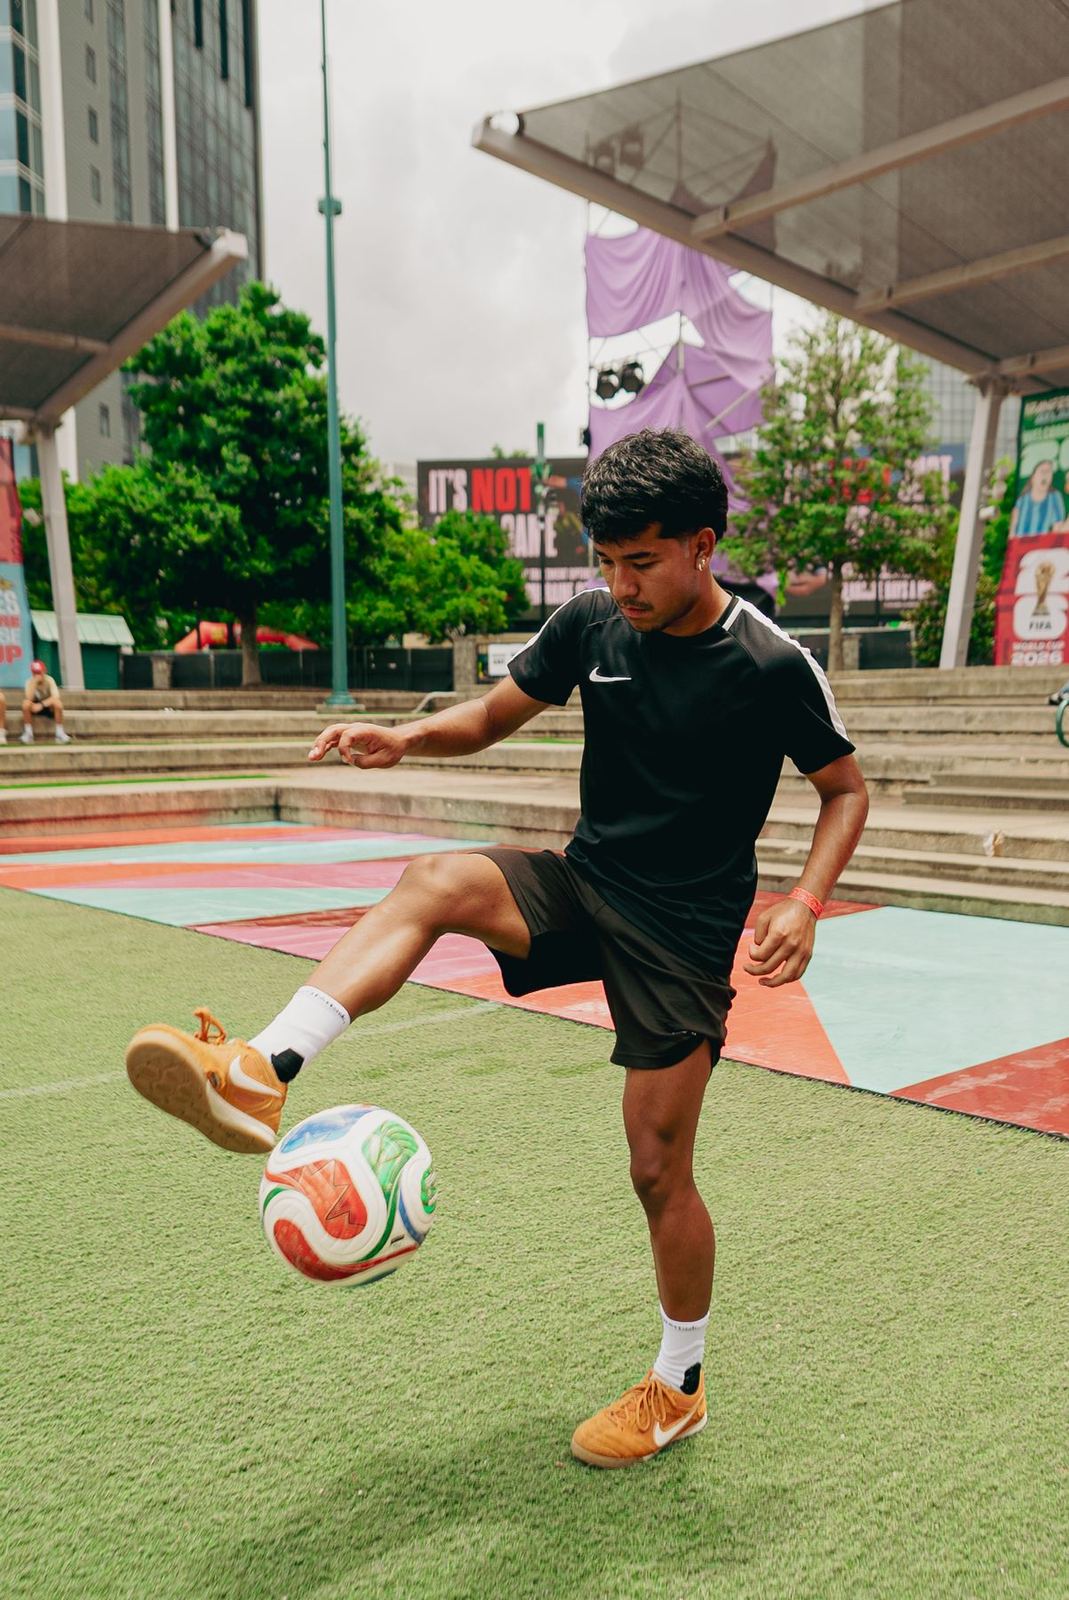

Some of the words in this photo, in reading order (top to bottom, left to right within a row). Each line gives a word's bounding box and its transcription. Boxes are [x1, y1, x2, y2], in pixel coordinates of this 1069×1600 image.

[429, 468, 467, 513] IT'S
[471, 467, 531, 513] NOT
[1029, 621, 1052, 631] FIFA
[1011, 650, 1064, 667] 2026
